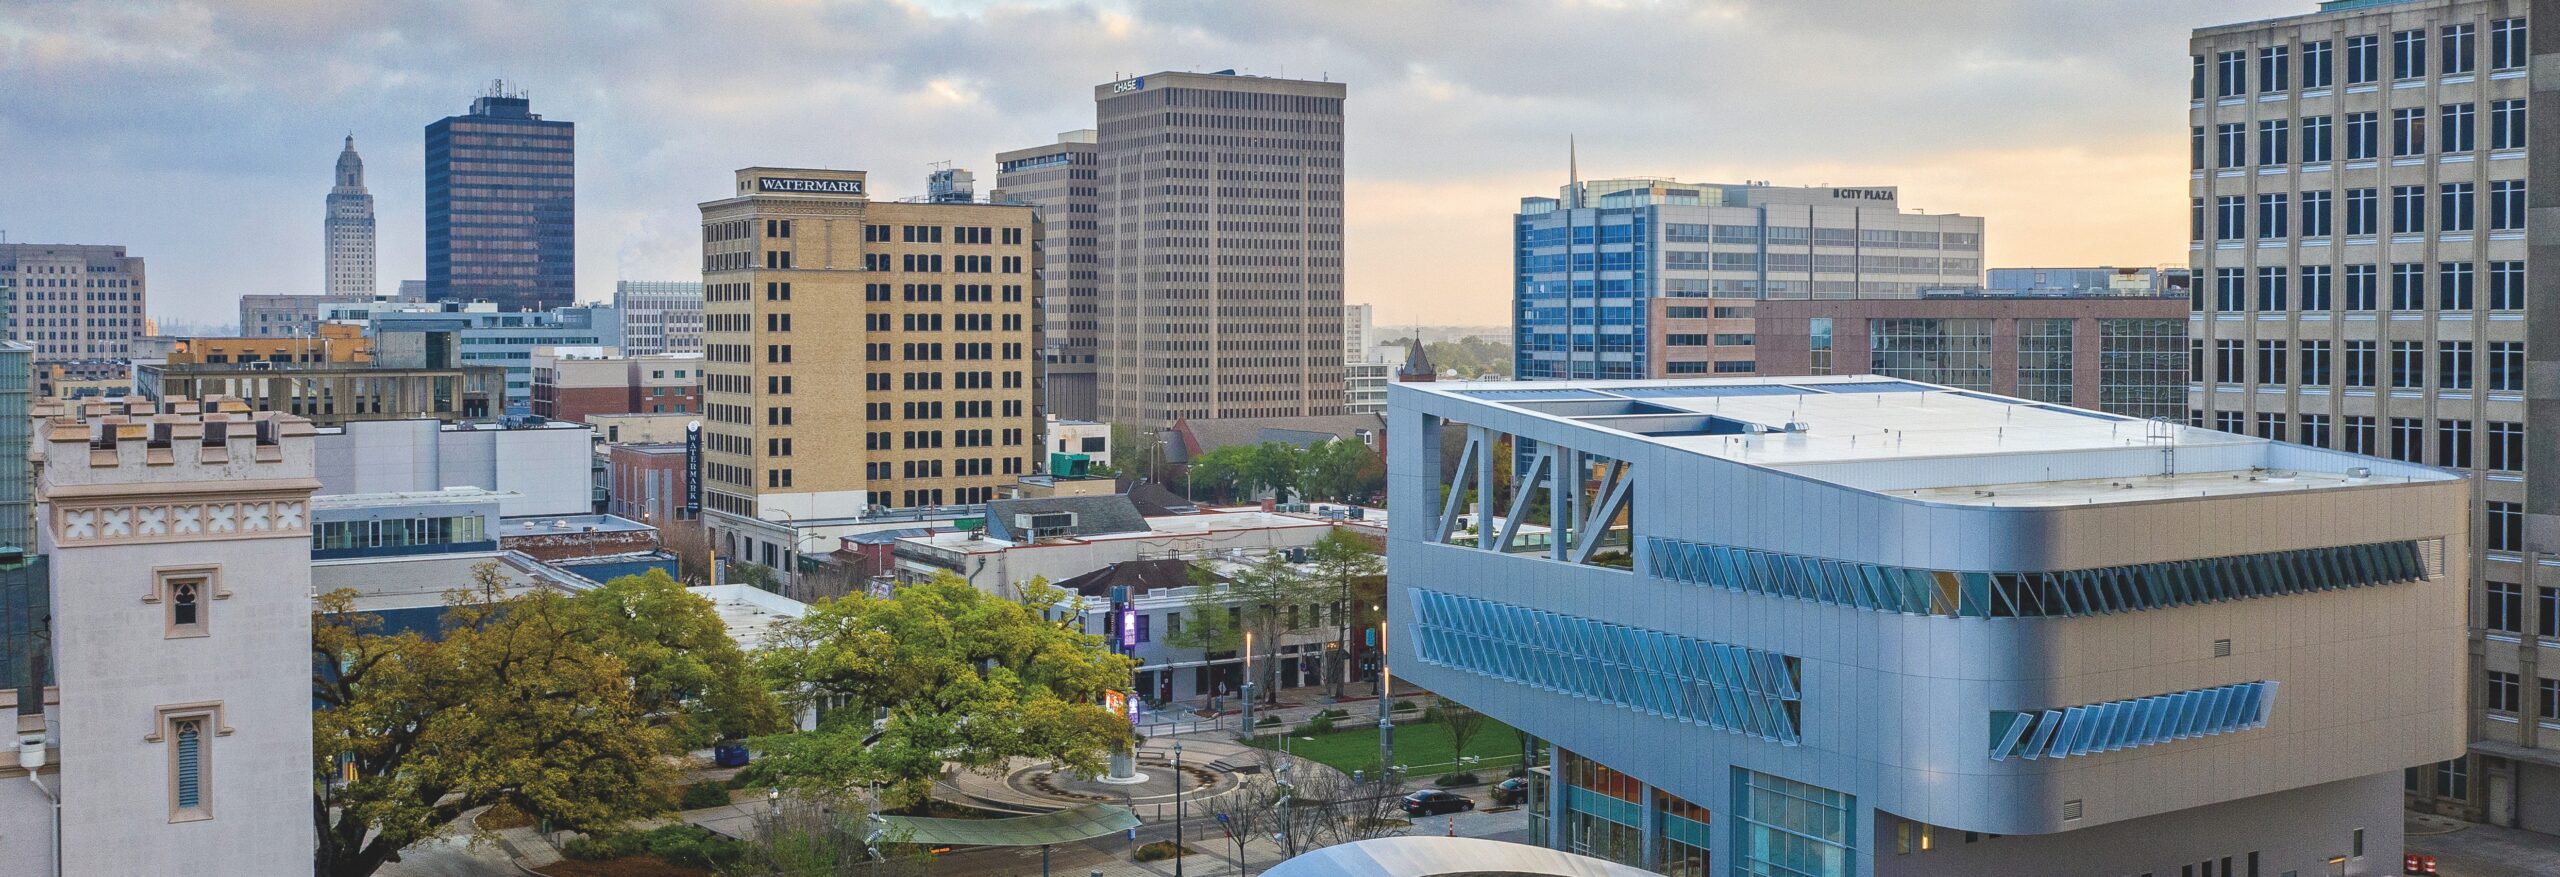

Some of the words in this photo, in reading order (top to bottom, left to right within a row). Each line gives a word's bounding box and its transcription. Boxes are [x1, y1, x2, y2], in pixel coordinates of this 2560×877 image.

[1113, 79, 1137, 93] CHASE
[762, 179, 861, 192] WATERMARK
[1841, 188, 1862, 199] CITY
[1864, 190, 1894, 201] PLAZA
[689, 434, 697, 499] WATERMARK
